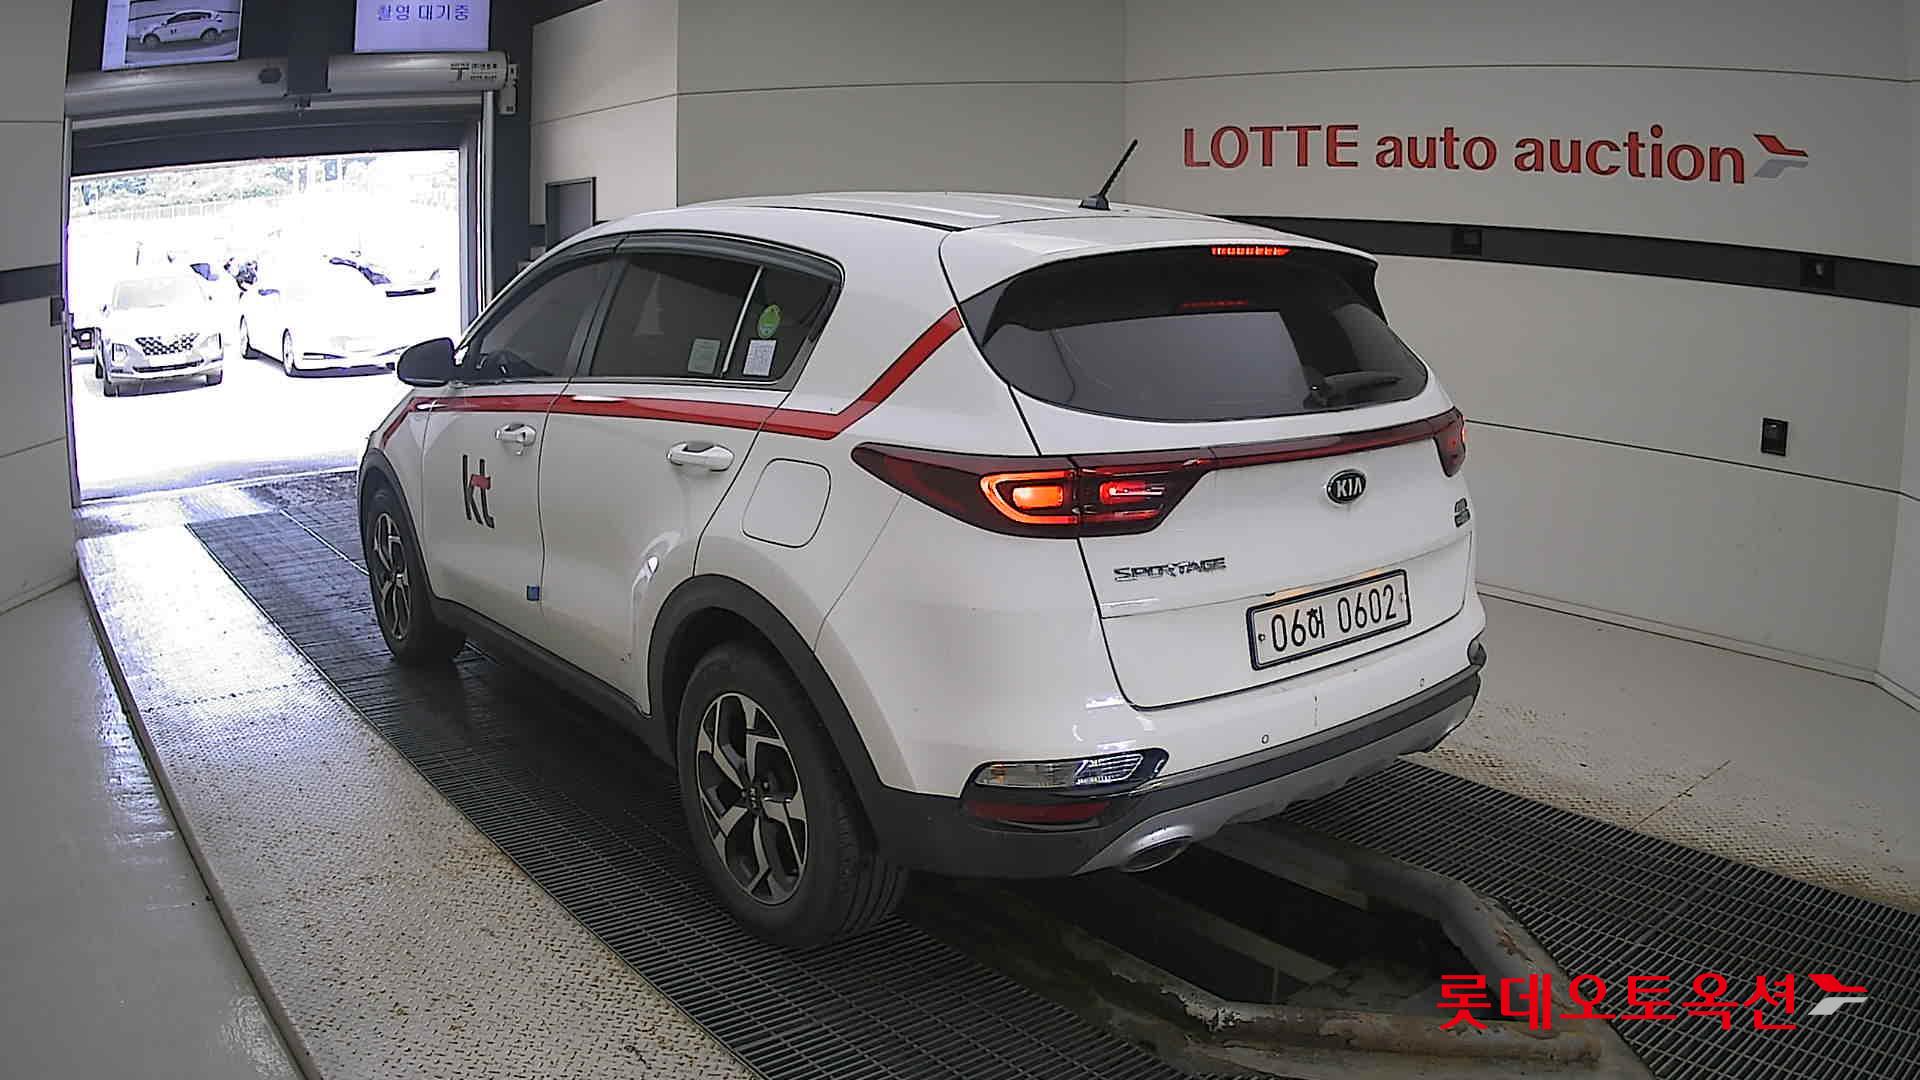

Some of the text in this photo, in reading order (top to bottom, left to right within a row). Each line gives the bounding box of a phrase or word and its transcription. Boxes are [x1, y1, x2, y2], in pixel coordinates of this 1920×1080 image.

[418, 4, 468, 21] 대기중
[1184, 124, 1746, 184] LOTTE auto auction
[462, 454, 495, 529] kt
[1335, 477, 1363, 498] KIA
[1113, 557, 1227, 582] SPORTAGE
[1271, 584, 1397, 652] 06허 0602
